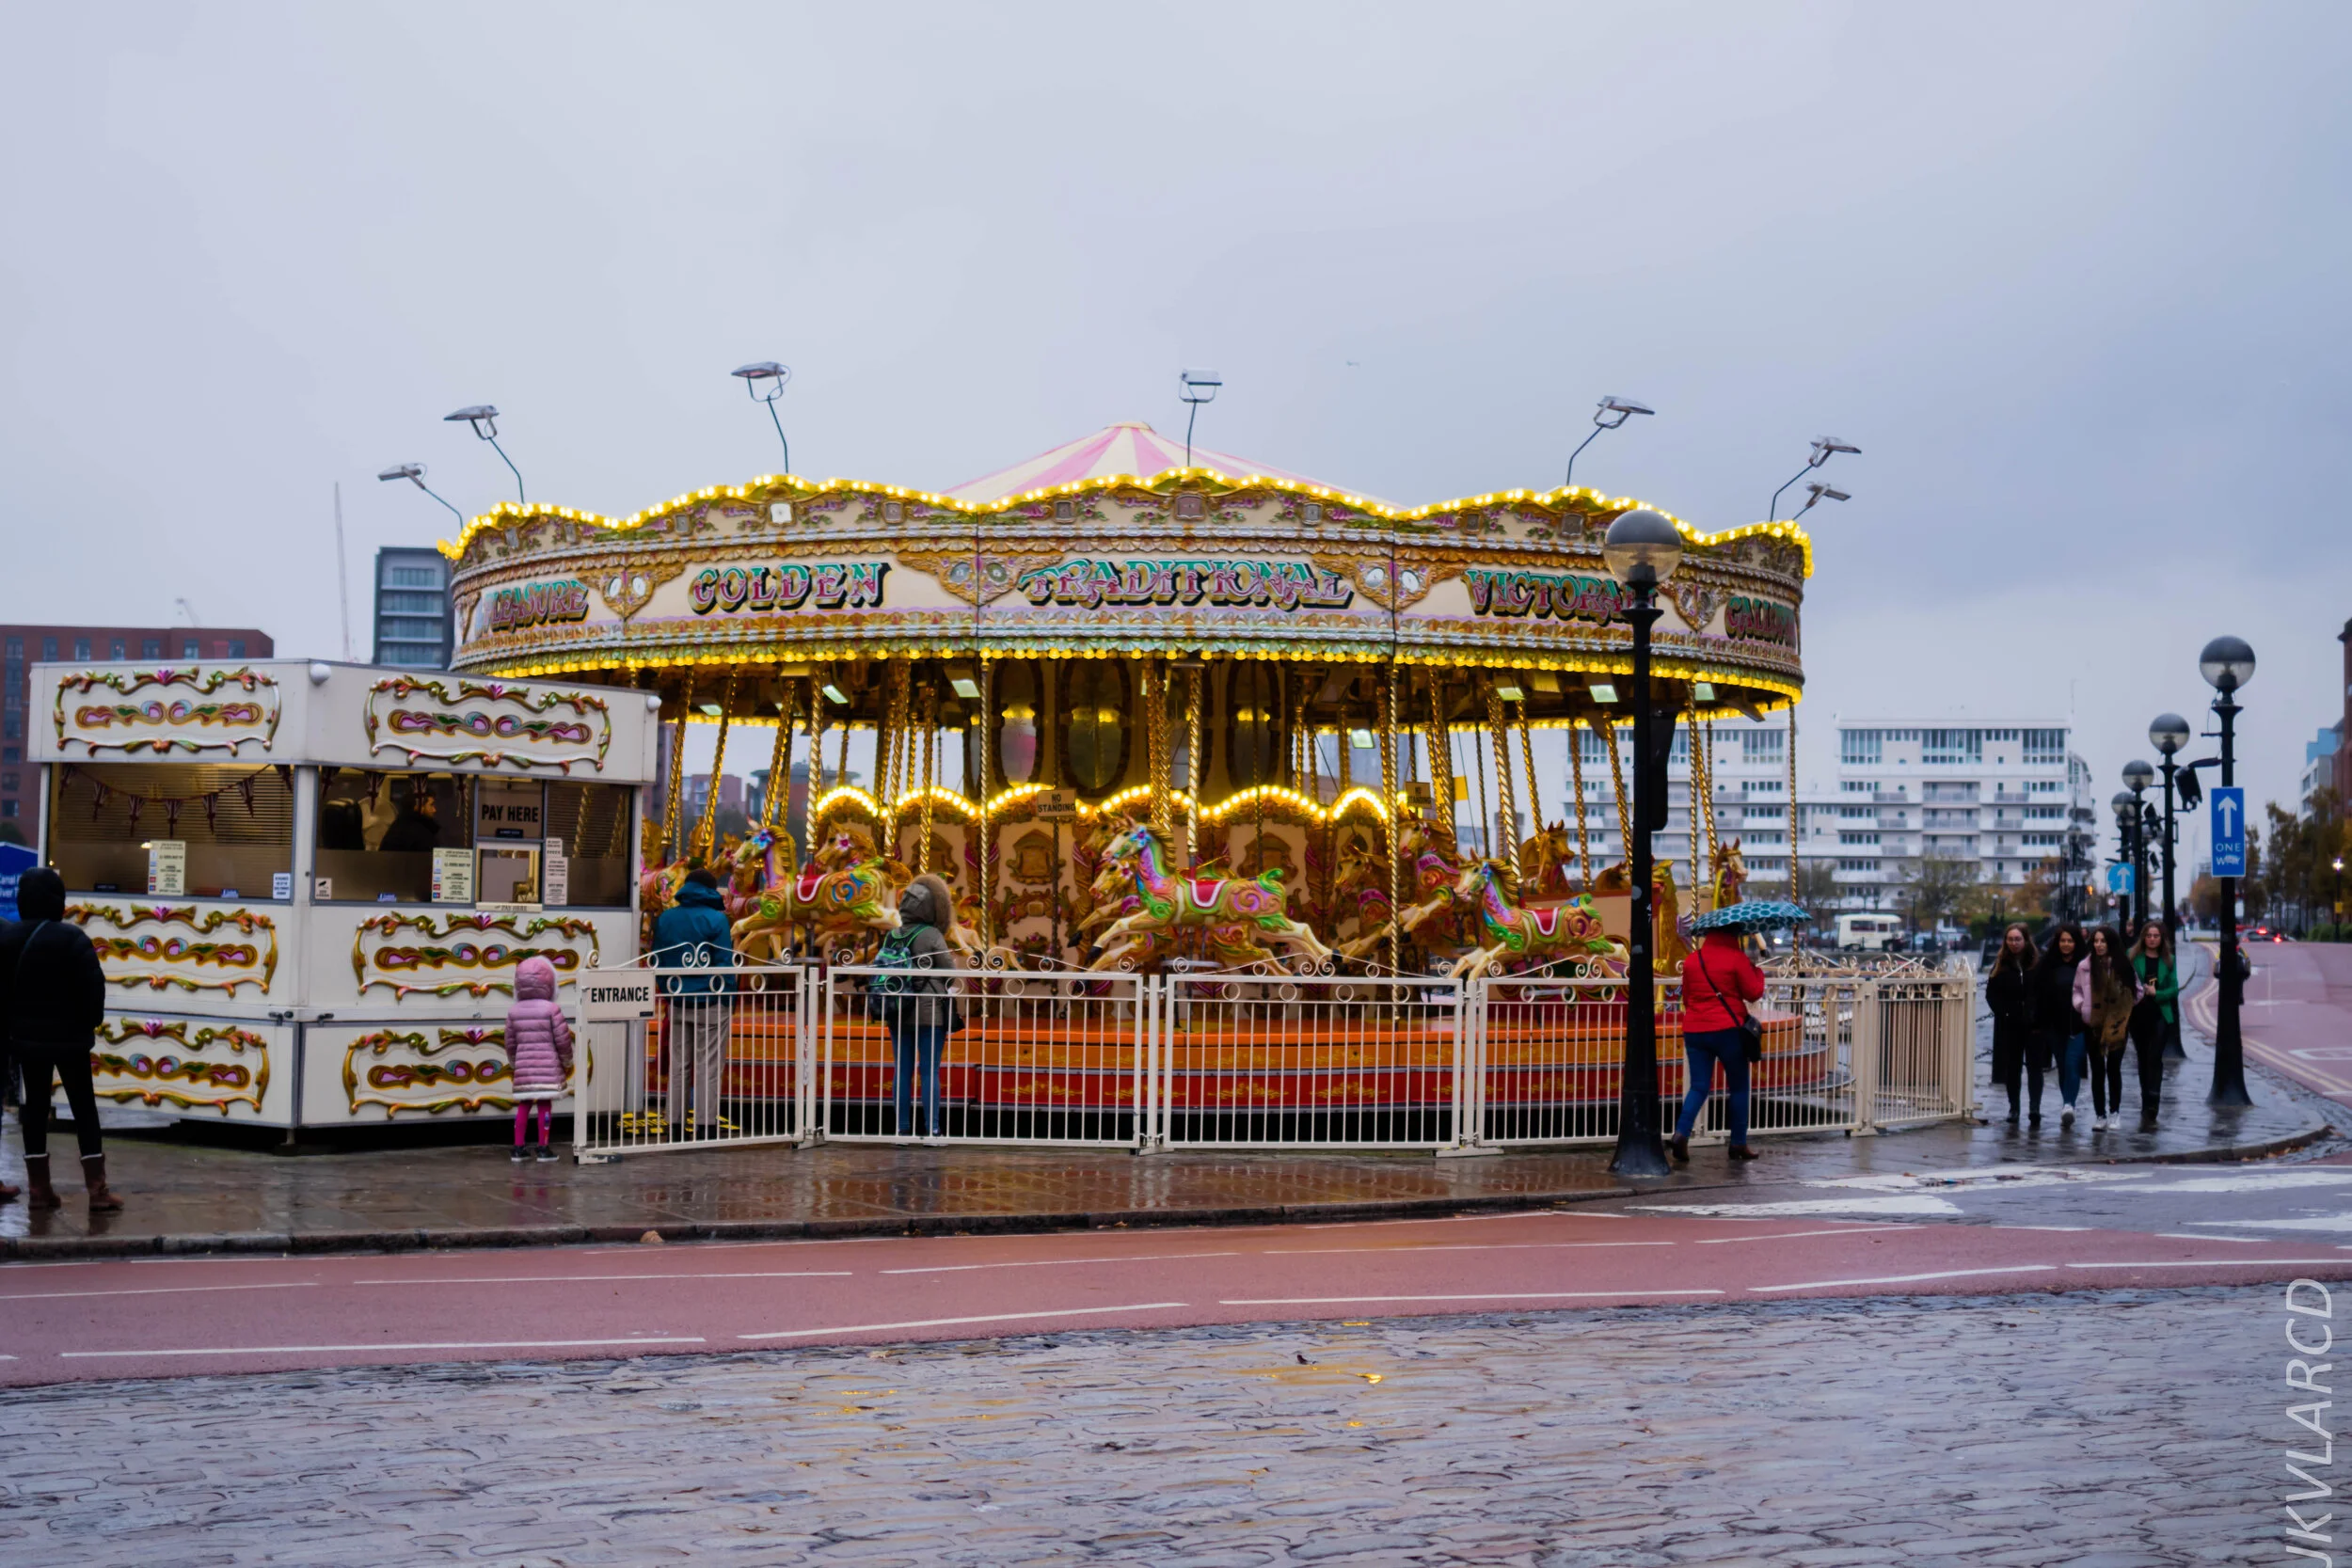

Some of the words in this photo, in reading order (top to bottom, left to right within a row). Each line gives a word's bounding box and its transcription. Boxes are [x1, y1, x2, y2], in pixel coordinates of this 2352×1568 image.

[688, 562, 890, 614] GOLDEN
[1018, 558, 1355, 611] TRADITIONAL
[1051, 793, 1061, 802] NO
[482, 804, 503, 820] PAY
[508, 806, 539, 822] HERE
[1038, 803, 1075, 813] STANDING
[2216, 843, 2241, 852] ONE
[591, 987, 649, 1003] ENTRANCE
